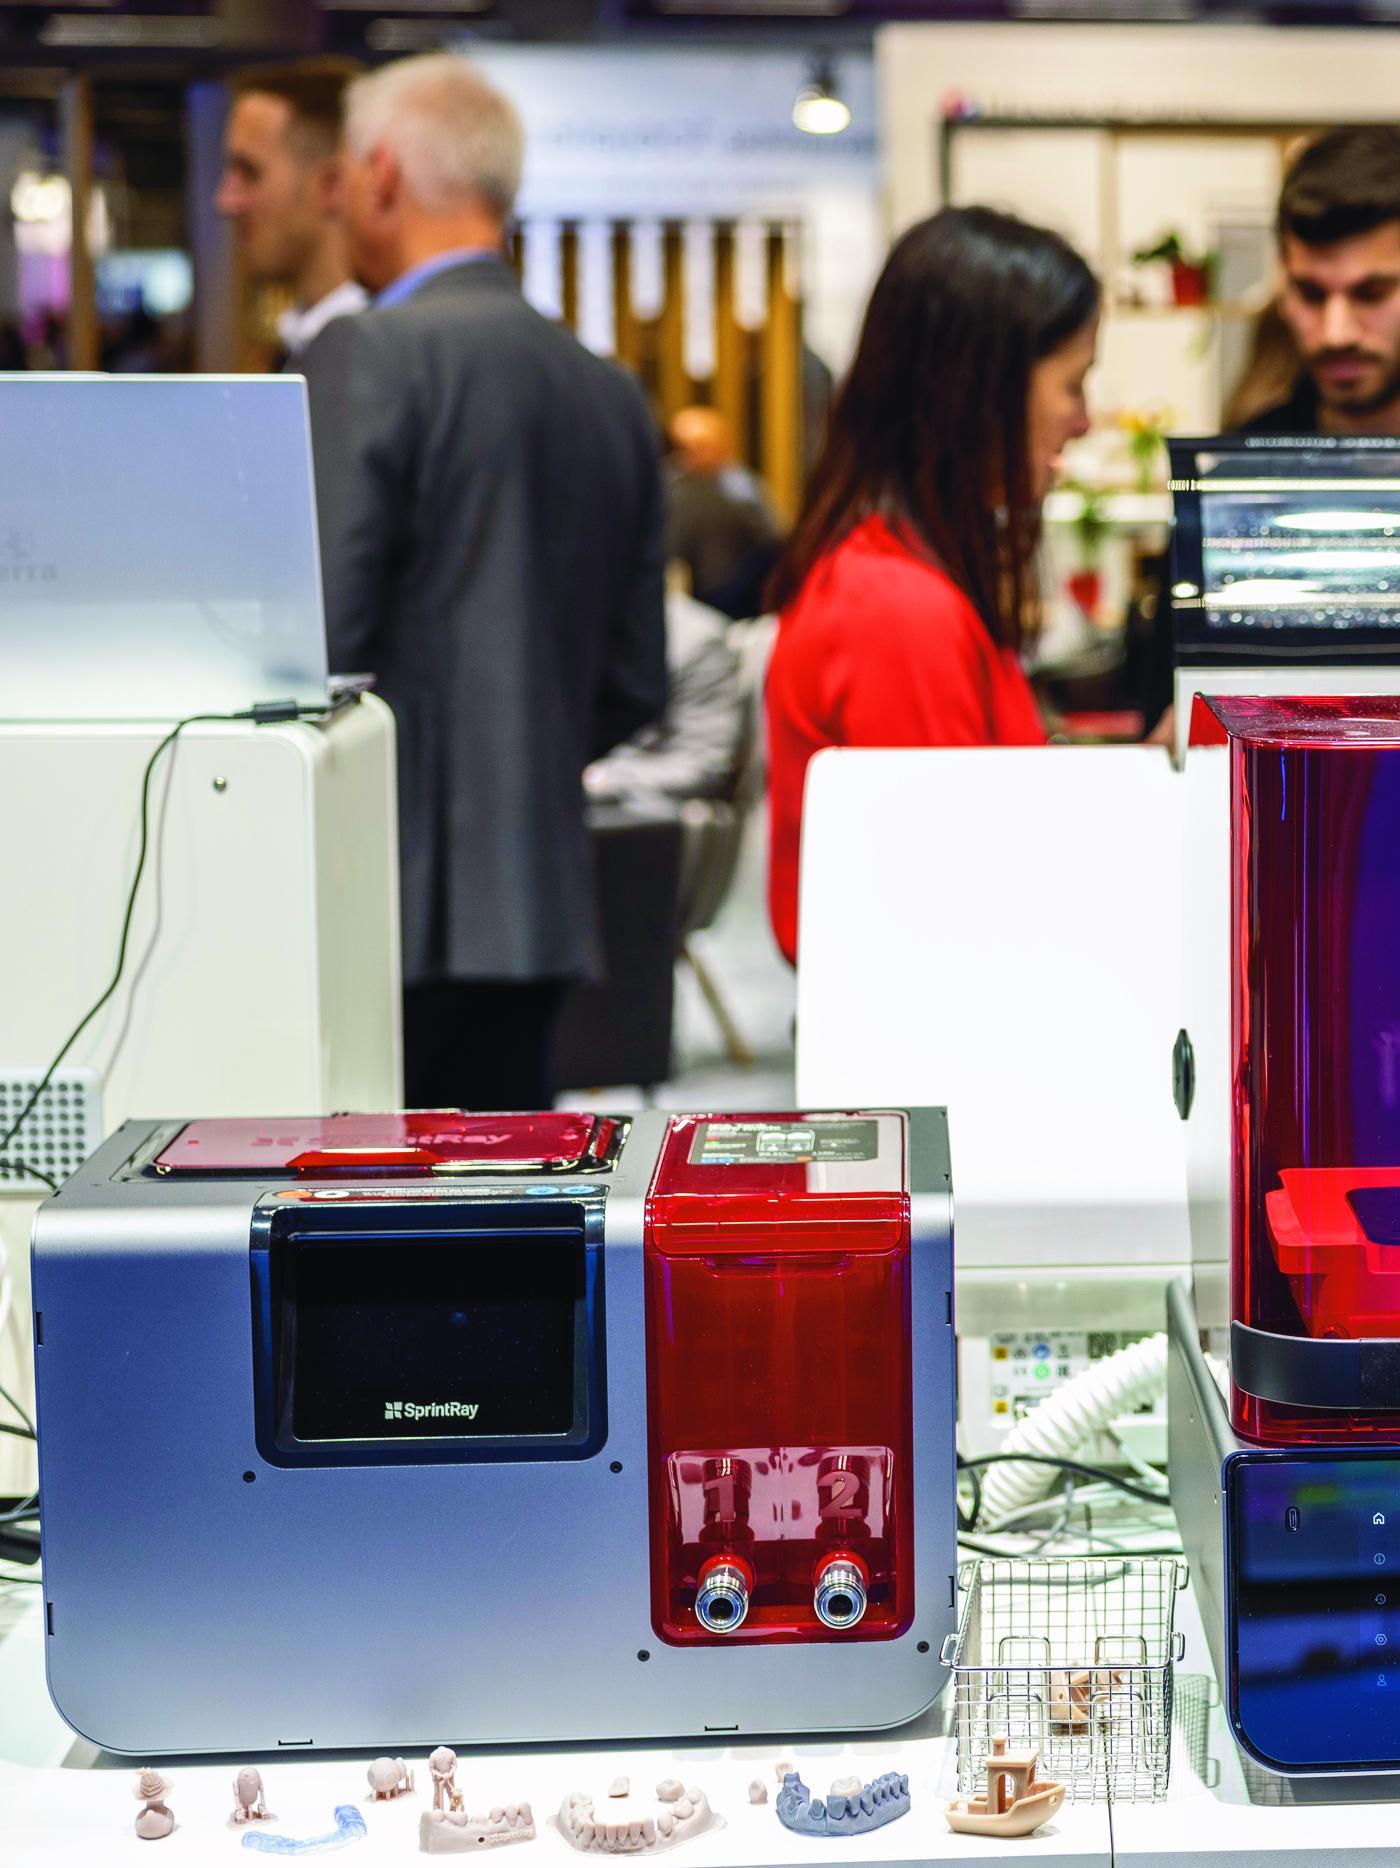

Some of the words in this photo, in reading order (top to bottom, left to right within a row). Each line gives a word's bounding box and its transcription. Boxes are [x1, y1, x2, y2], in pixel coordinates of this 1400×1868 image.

[403, 1401, 480, 1421] SprintRay
[704, 1474, 736, 1522] 1
[818, 1470, 863, 1518] 2
